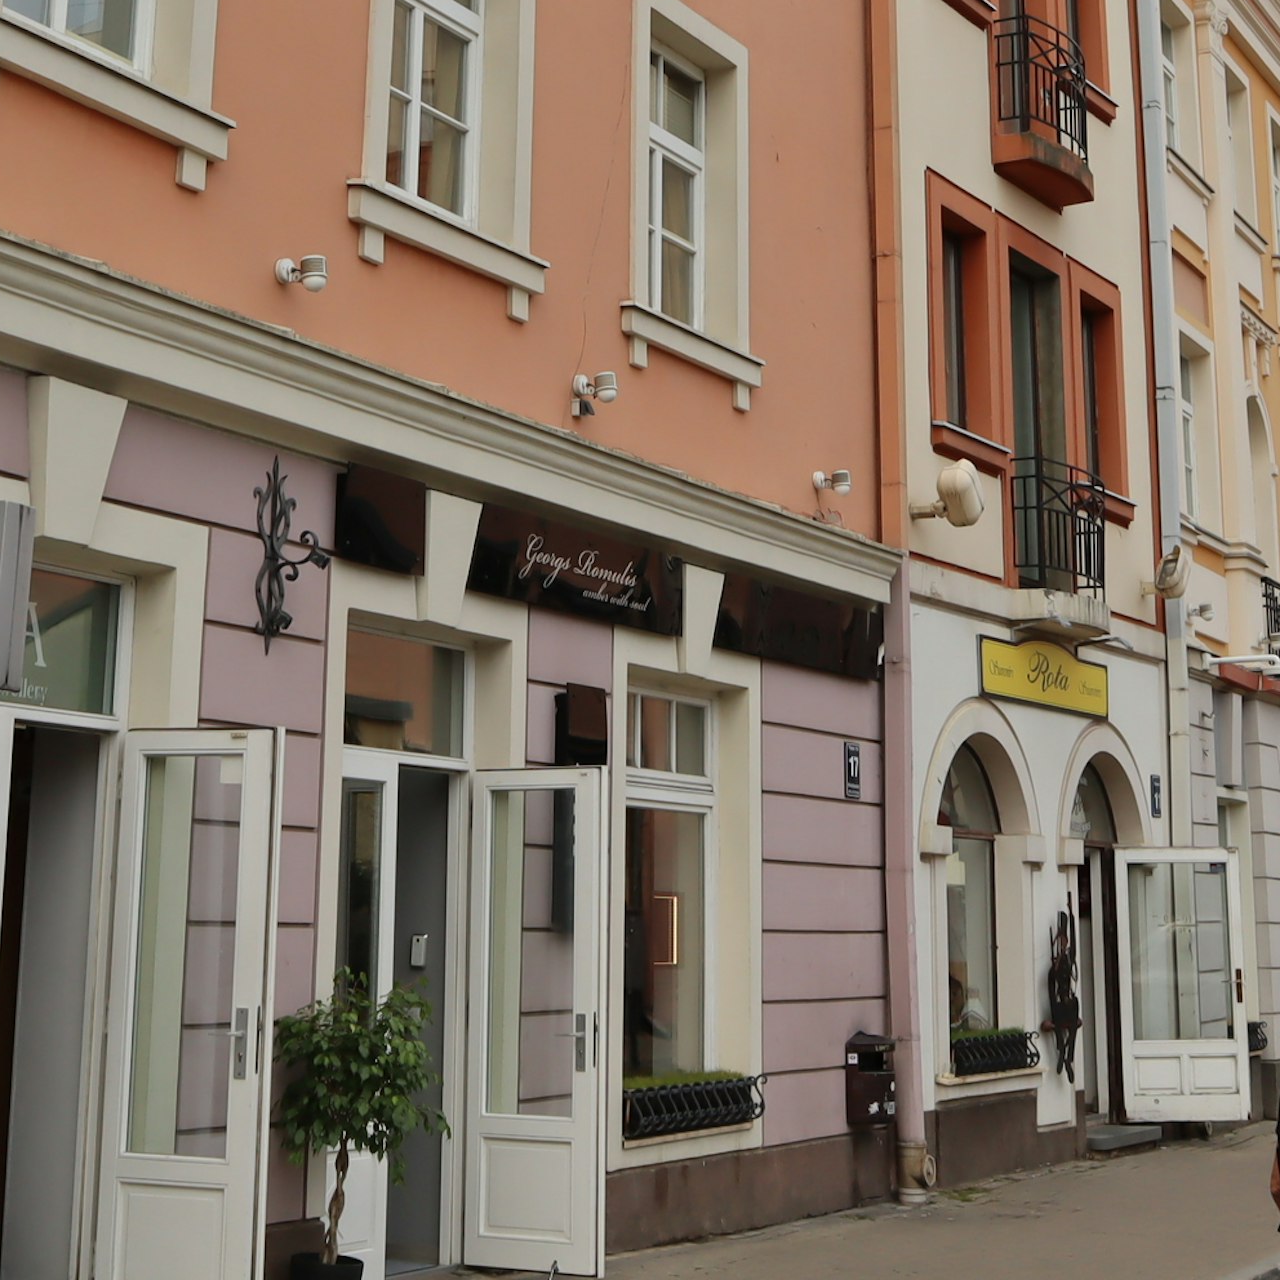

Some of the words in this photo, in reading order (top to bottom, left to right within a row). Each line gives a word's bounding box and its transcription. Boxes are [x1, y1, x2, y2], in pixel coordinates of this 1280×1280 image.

[519, 533, 571, 588] Georgs
[573, 550, 637, 587] Romulis
[582, 582, 609, 602] amber
[609, 587, 634, 607] with
[629, 596, 651, 612] soul
[1027, 650, 1070, 692] Rota
[849, 756, 859, 777] 17
